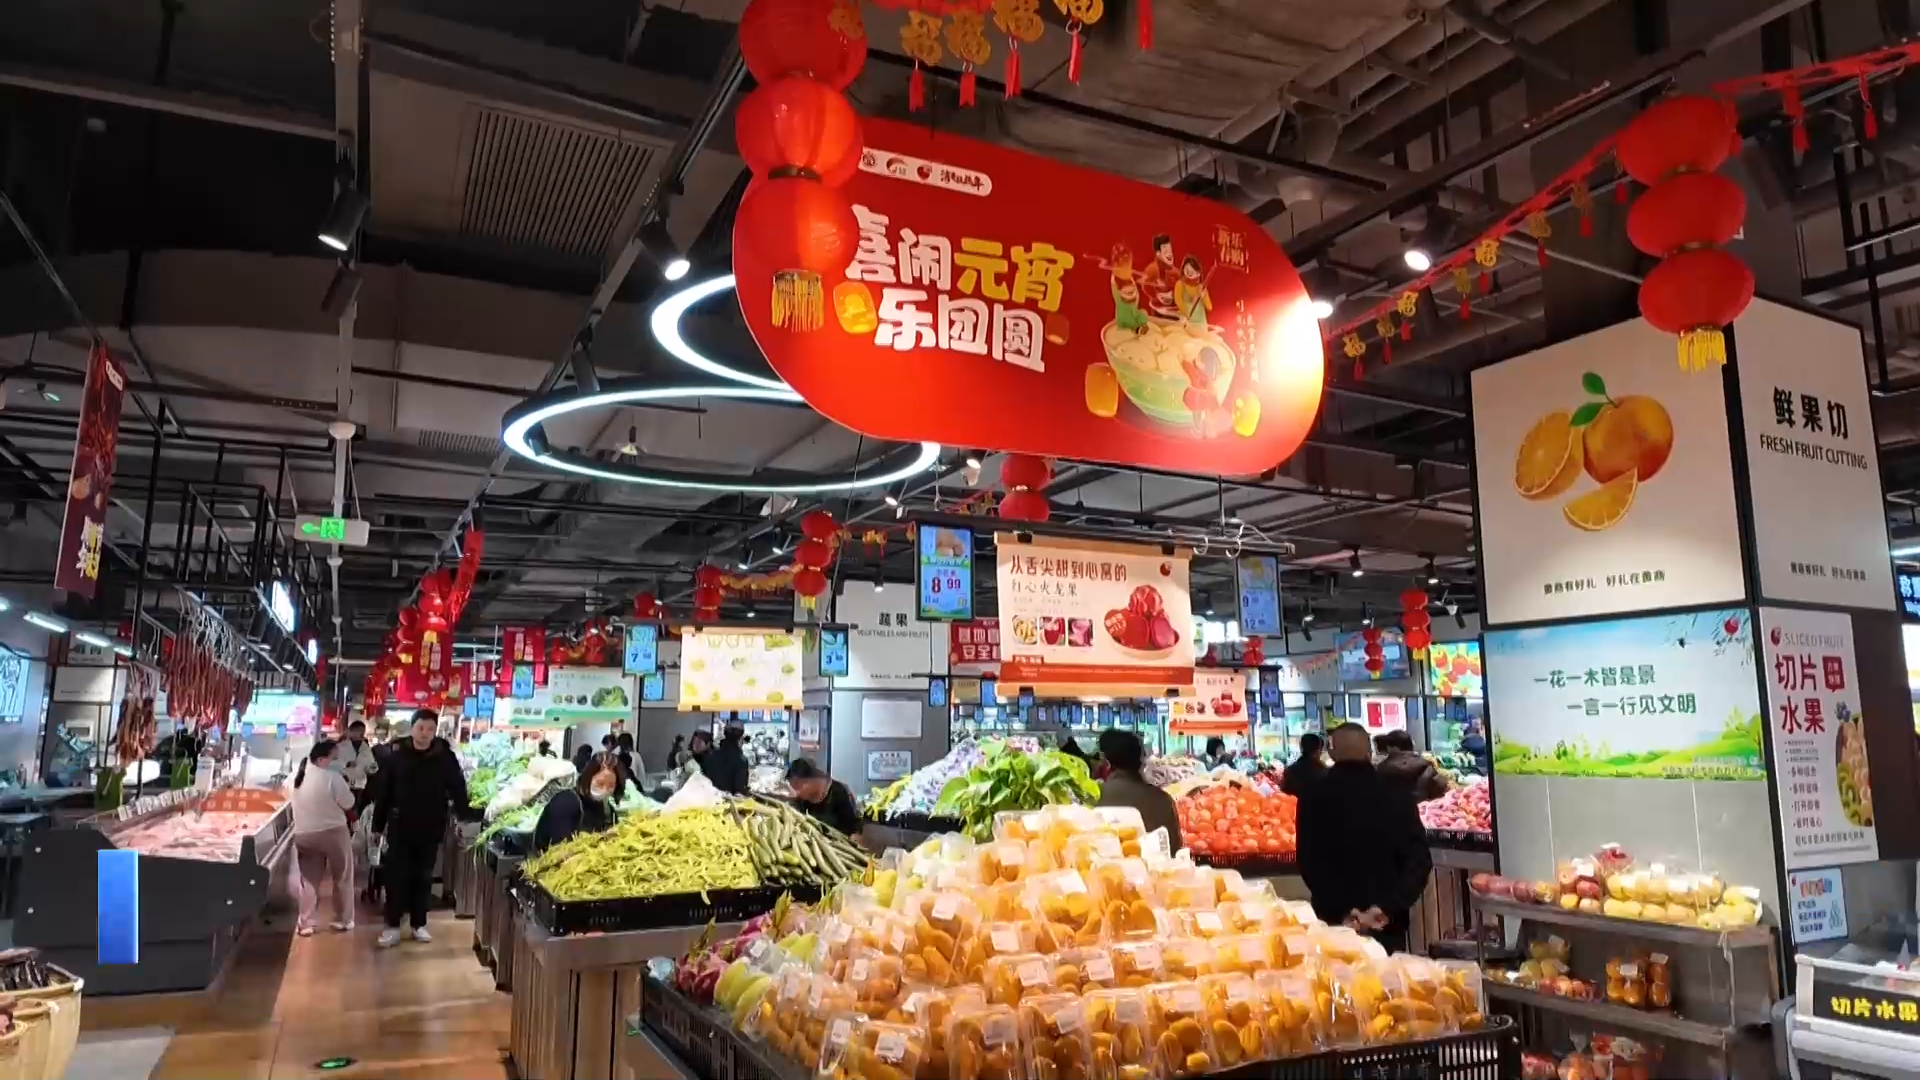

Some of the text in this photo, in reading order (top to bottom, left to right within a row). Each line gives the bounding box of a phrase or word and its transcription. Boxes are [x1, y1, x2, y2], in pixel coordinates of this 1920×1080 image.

[845, 203, 1075, 313] 喜闹元宵
[874, 288, 1045, 373] 乐团圆
[1774, 386, 1848, 440] 鲜果切
[1760, 433, 1868, 470] FRESH FRUIT CUTTING
[1010, 554, 1127, 582] 从舌尖甜到心窝的
[1011, 578, 1078, 597] 红心火龙果
[878, 612, 908, 627] 蔬果
[1784, 632, 1817, 647] SLICED
[1534, 664, 1656, 689] 一花一木皆是景
[1775, 653, 1817, 691] 切片
[1566, 693, 1696, 716] 一言一行见文明
[1780, 695, 1825, 735] 水果
[1830, 996, 1918, 1022] 切片水果
